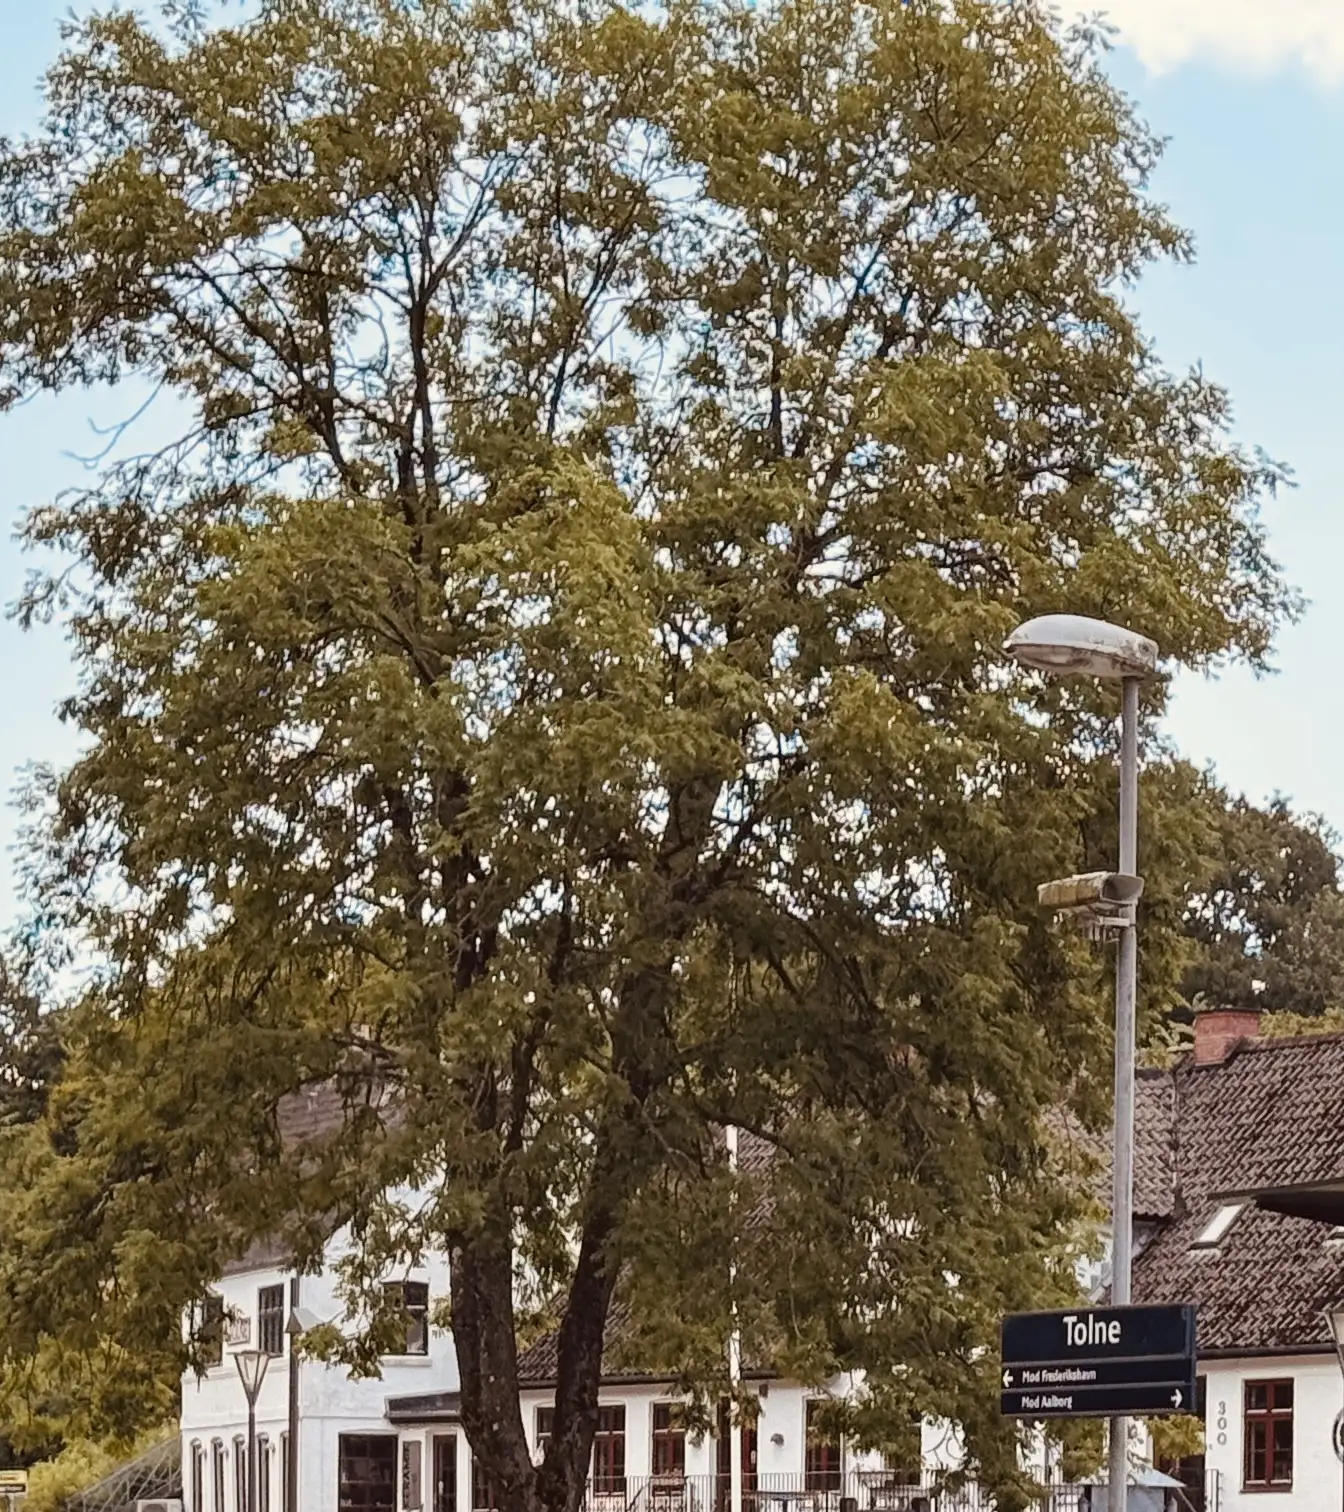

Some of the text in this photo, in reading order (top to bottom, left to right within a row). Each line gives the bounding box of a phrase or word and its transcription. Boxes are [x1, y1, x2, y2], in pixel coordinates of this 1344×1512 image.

[1062, 1313, 1121, 1346] Tolne
[1022, 1367, 1097, 1383] Mod Frederikshavn
[1021, 1394, 1073, 1410] Mod Aalborg
